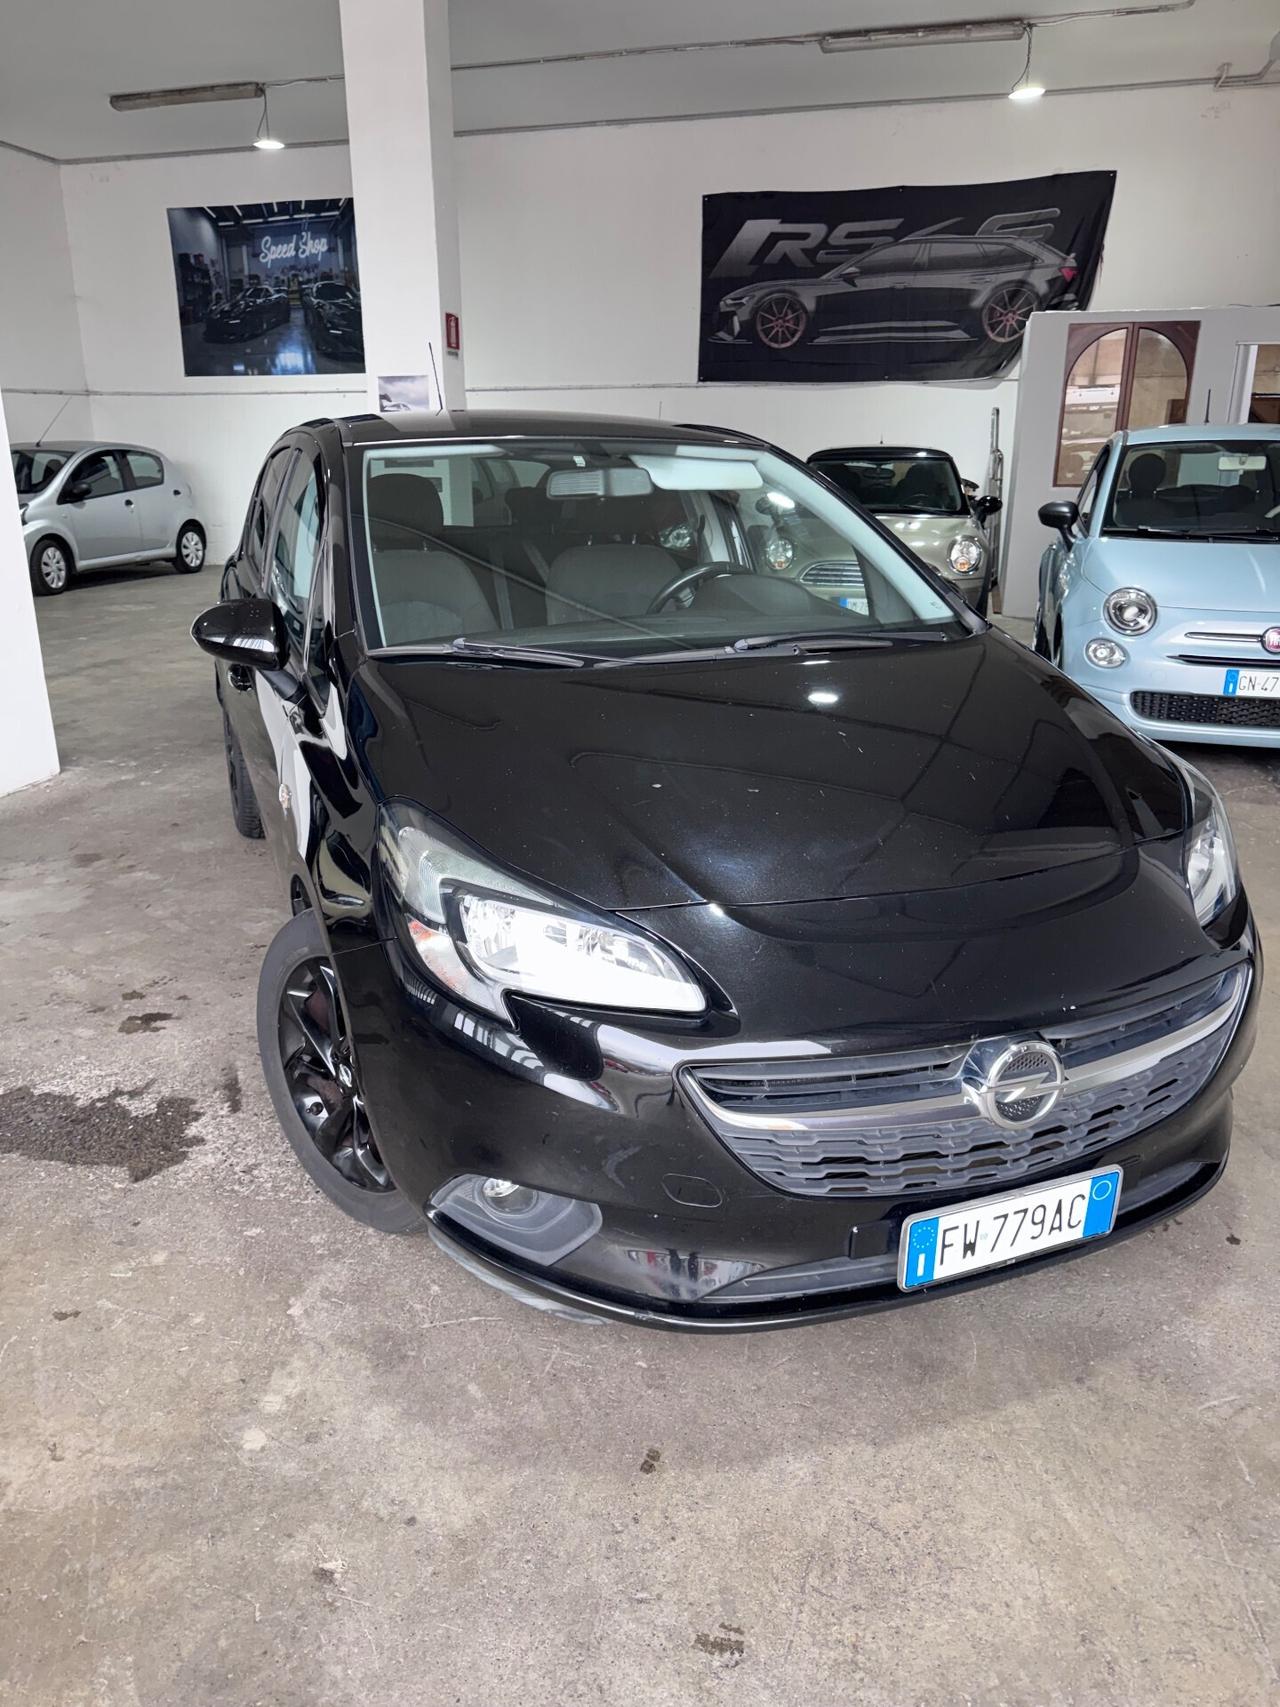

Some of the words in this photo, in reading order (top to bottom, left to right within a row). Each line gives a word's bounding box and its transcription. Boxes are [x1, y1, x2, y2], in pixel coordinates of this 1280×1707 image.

[259, 234, 297, 268] Speed
[298, 231, 328, 261] Shop
[1238, 675, 1257, 692] GN
[938, 1219, 980, 1266] FW
[990, 1193, 1087, 1253] 779AC
